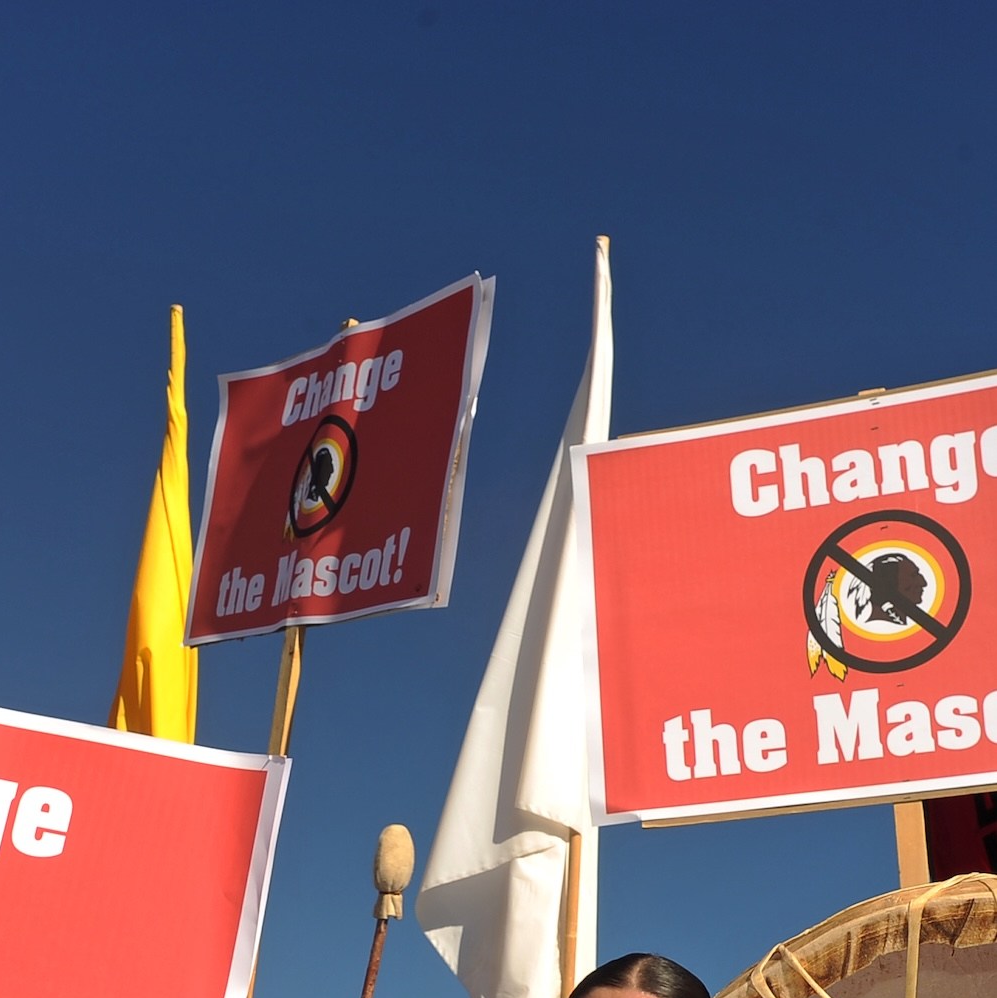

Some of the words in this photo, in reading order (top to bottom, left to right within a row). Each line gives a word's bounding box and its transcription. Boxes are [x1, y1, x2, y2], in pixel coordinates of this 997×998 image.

[281, 349, 404, 427] Change
[216, 567, 265, 618] the
[271, 526, 411, 607] Mascot!
[663, 709, 787, 781] the
